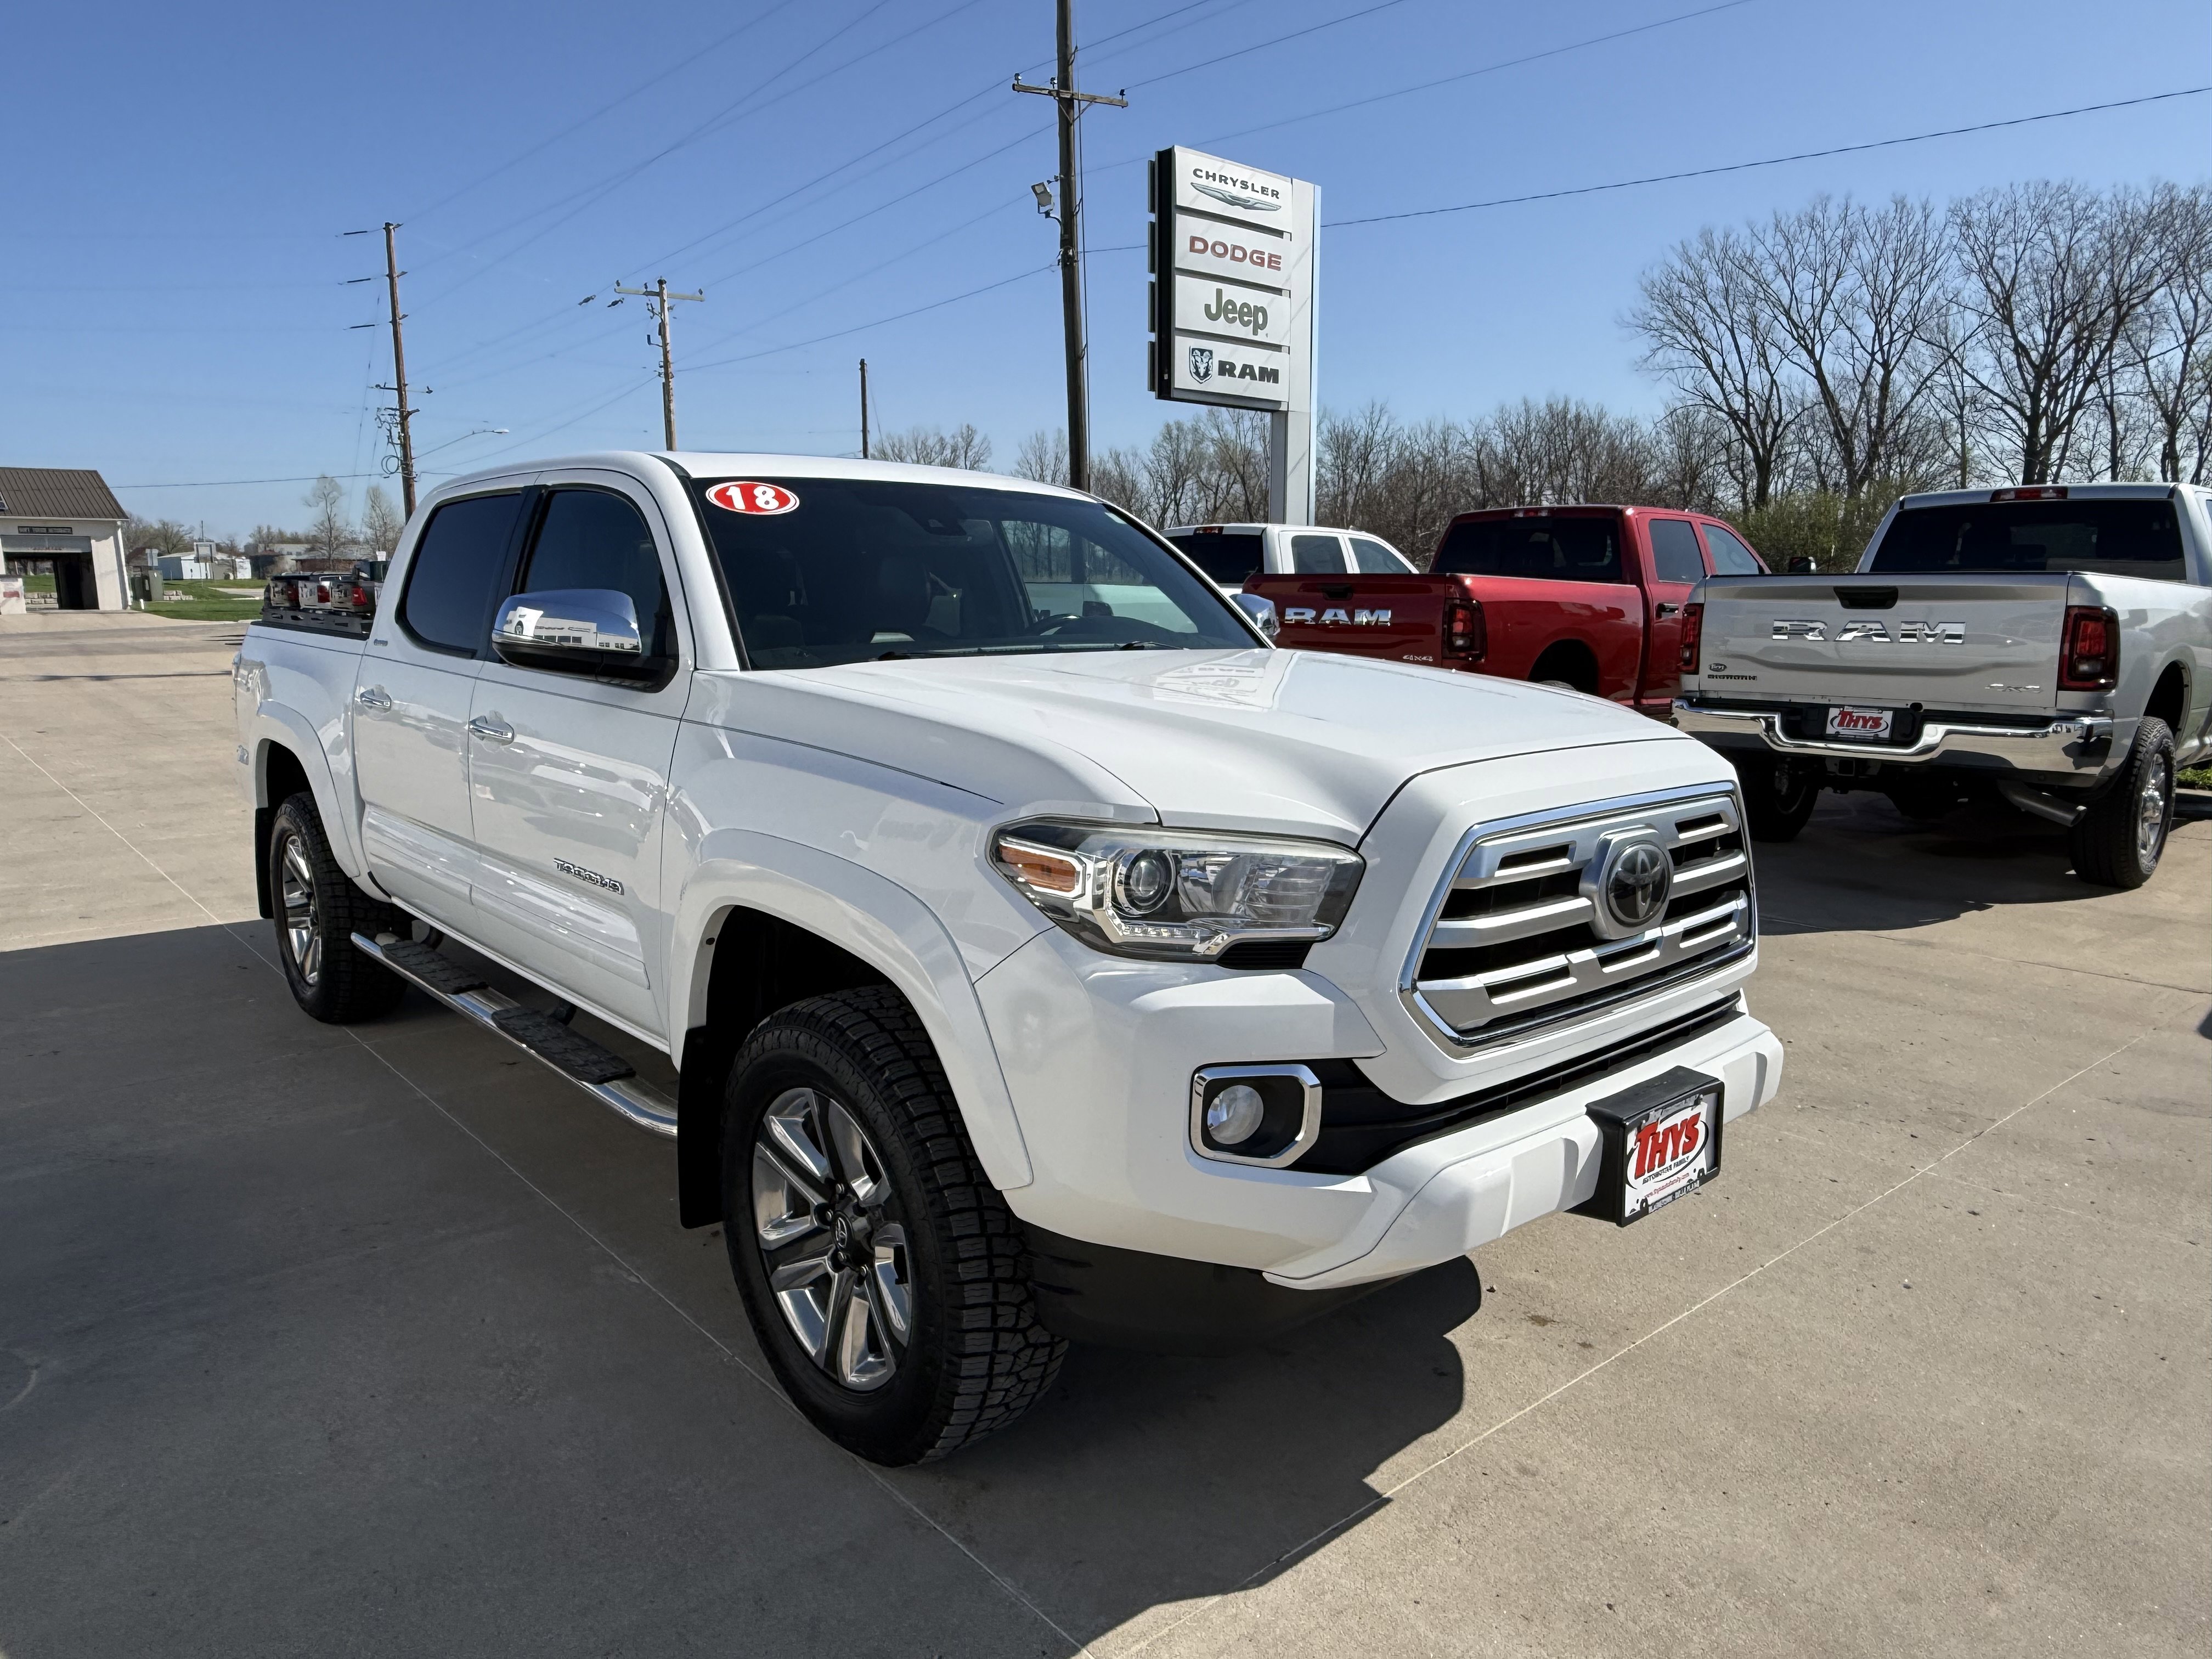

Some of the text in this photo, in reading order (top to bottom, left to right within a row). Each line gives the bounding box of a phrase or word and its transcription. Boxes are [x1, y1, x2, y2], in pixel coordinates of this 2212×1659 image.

[1193, 168, 1280, 199] CHRYSLER
[1189, 235, 1282, 271] DODGE
[1204, 288, 1268, 336] Jeep
[1218, 360, 1279, 384] RAM
[1284, 607, 1392, 627] RAM
[1772, 619, 1966, 645] RAM
[1837, 711, 1883, 729] THYS
[1634, 1112, 1702, 1180] THYS
